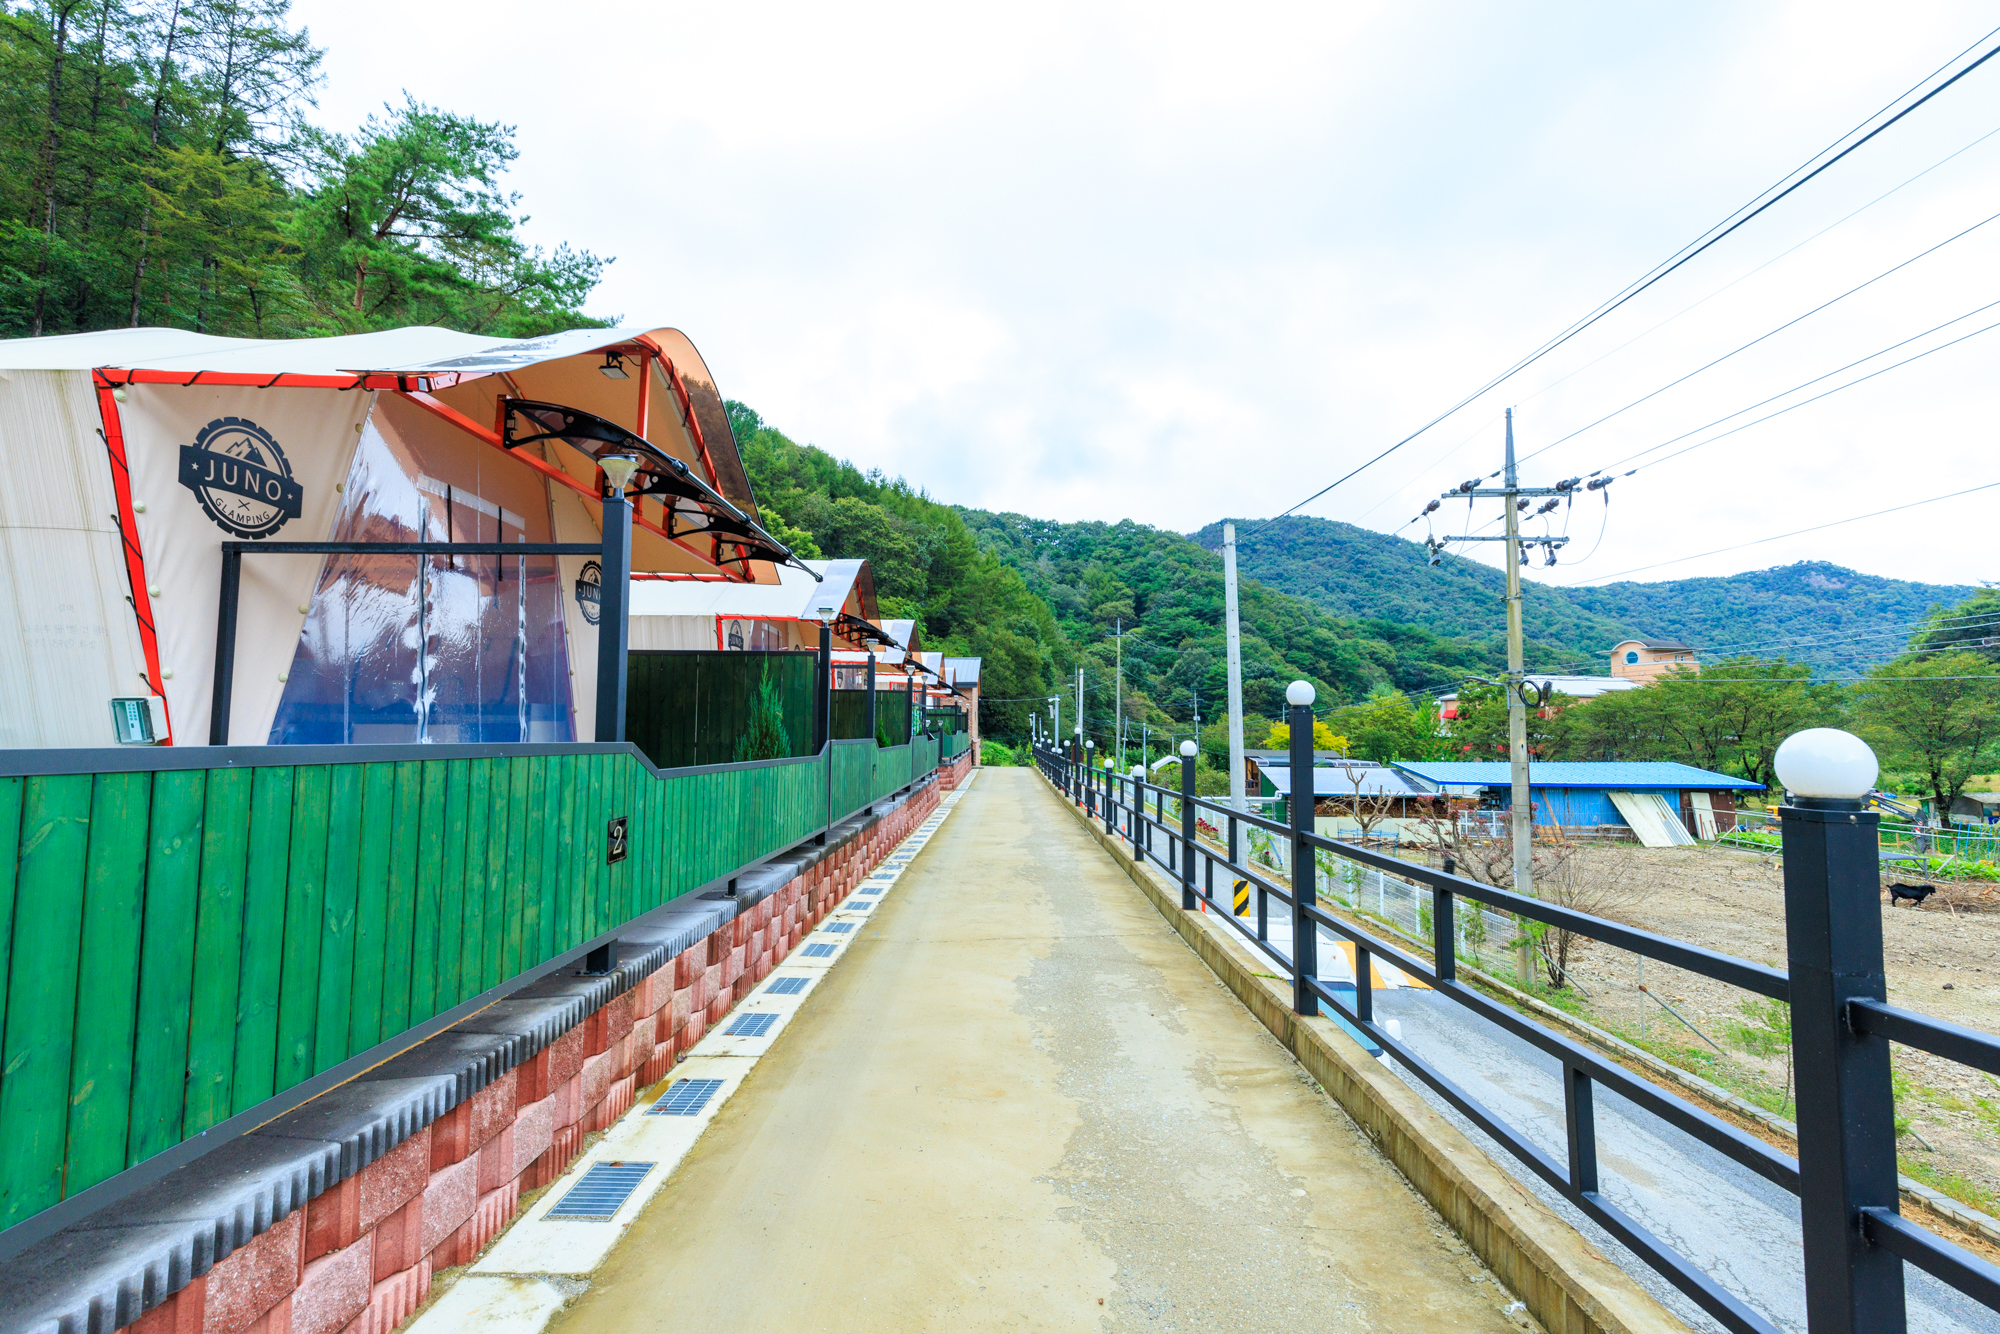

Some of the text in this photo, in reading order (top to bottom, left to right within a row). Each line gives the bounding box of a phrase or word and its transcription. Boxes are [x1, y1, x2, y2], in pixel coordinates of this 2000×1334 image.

[204, 459, 282, 501] JUNO
[214, 497, 271, 525] GLAMPING
[612, 825, 623, 855] 2
